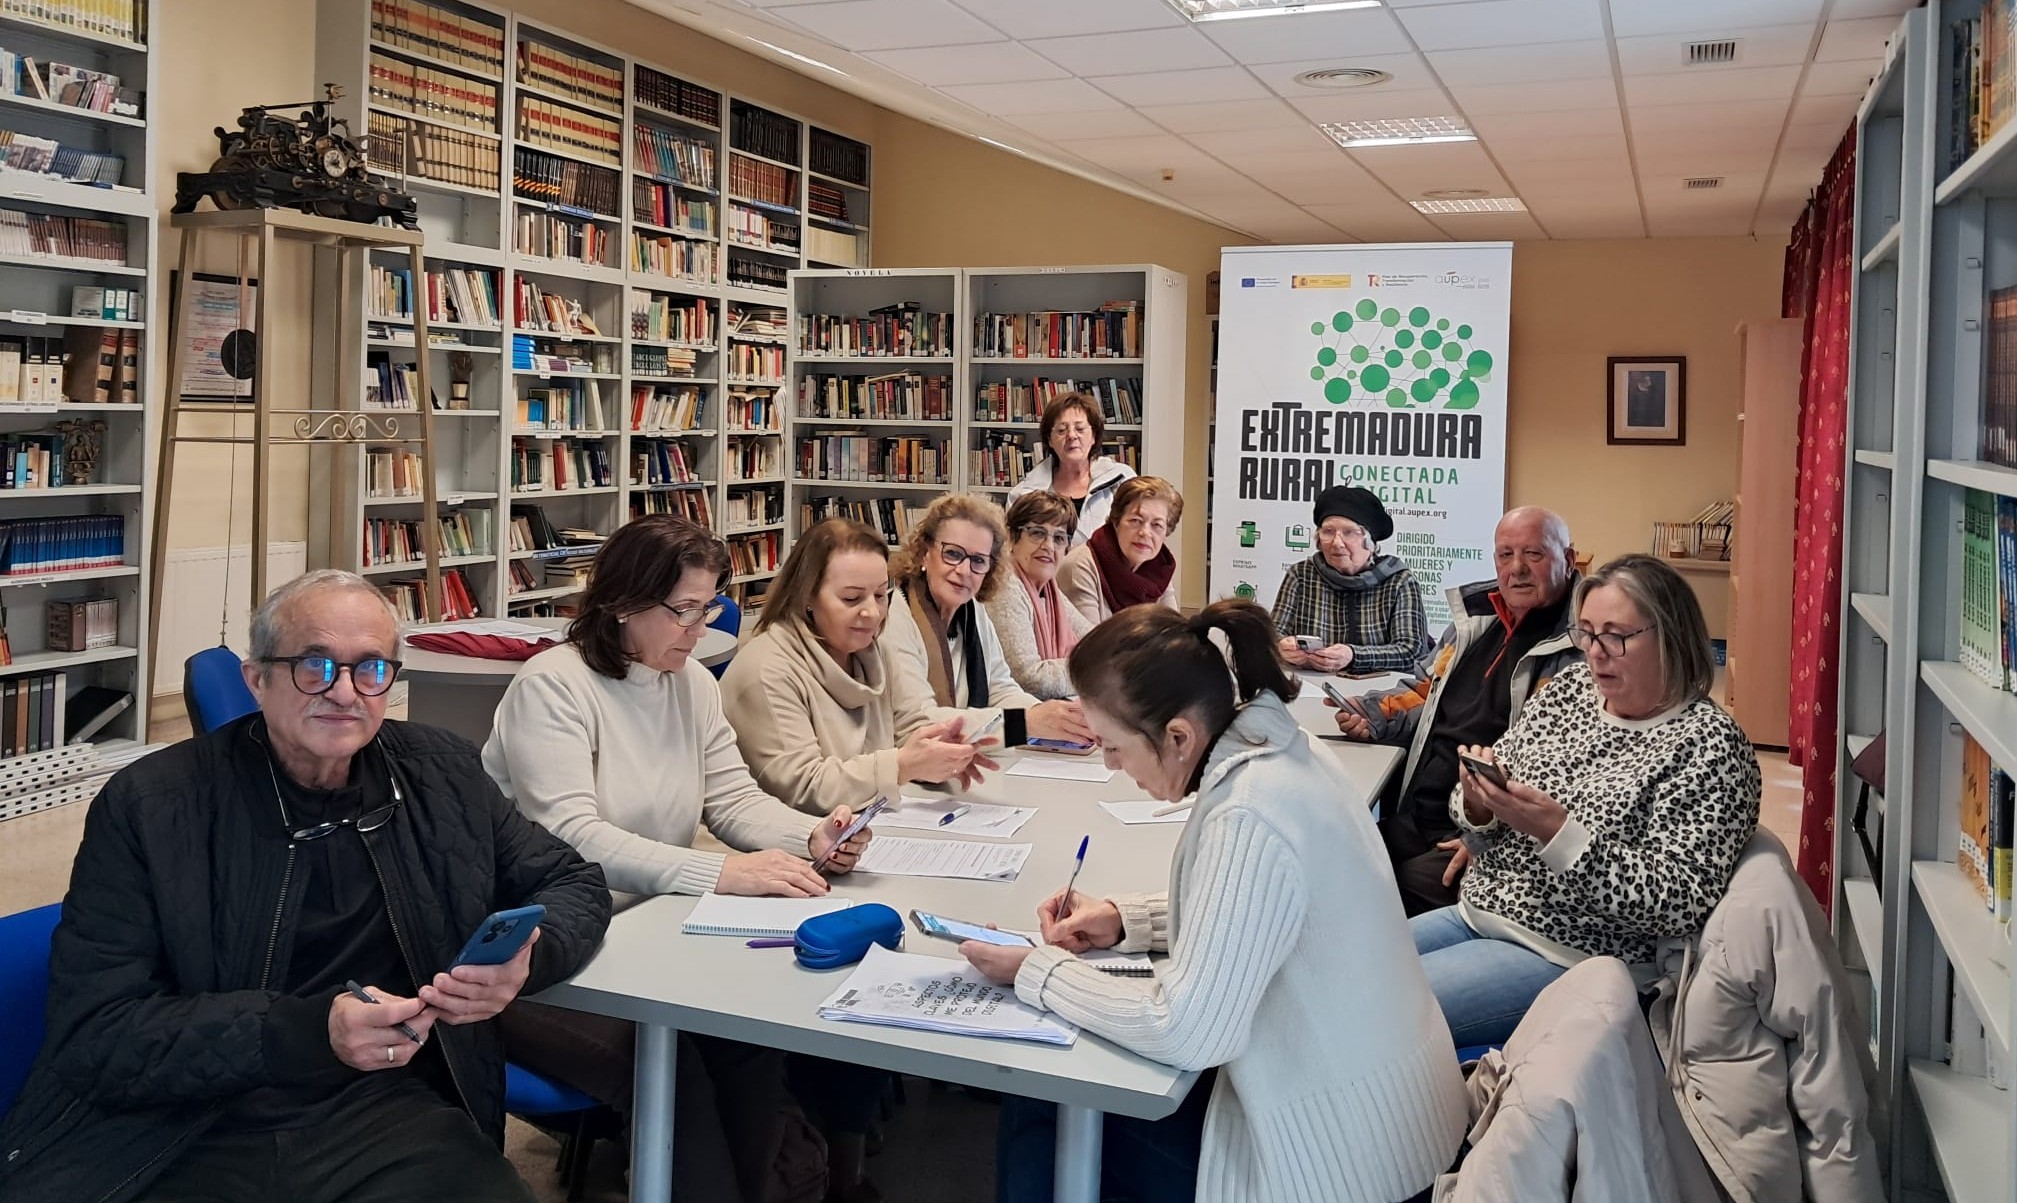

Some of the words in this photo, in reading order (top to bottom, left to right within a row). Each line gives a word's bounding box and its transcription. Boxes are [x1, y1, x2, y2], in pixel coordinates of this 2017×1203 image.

[1241, 402, 1482, 459] EXTREMADURA
[1339, 464, 1459, 485] CONECTADA
[1355, 484, 1437, 504] GITAL
[1396, 532, 1435, 545] DIRIGIDO
[1396, 545, 1484, 560] PRIORITARIAMENTE
[1404, 558, 1445, 571] MUJERES
[1447, 560, 1454, 571] Y
[1413, 571, 1442, 583] SONAS
